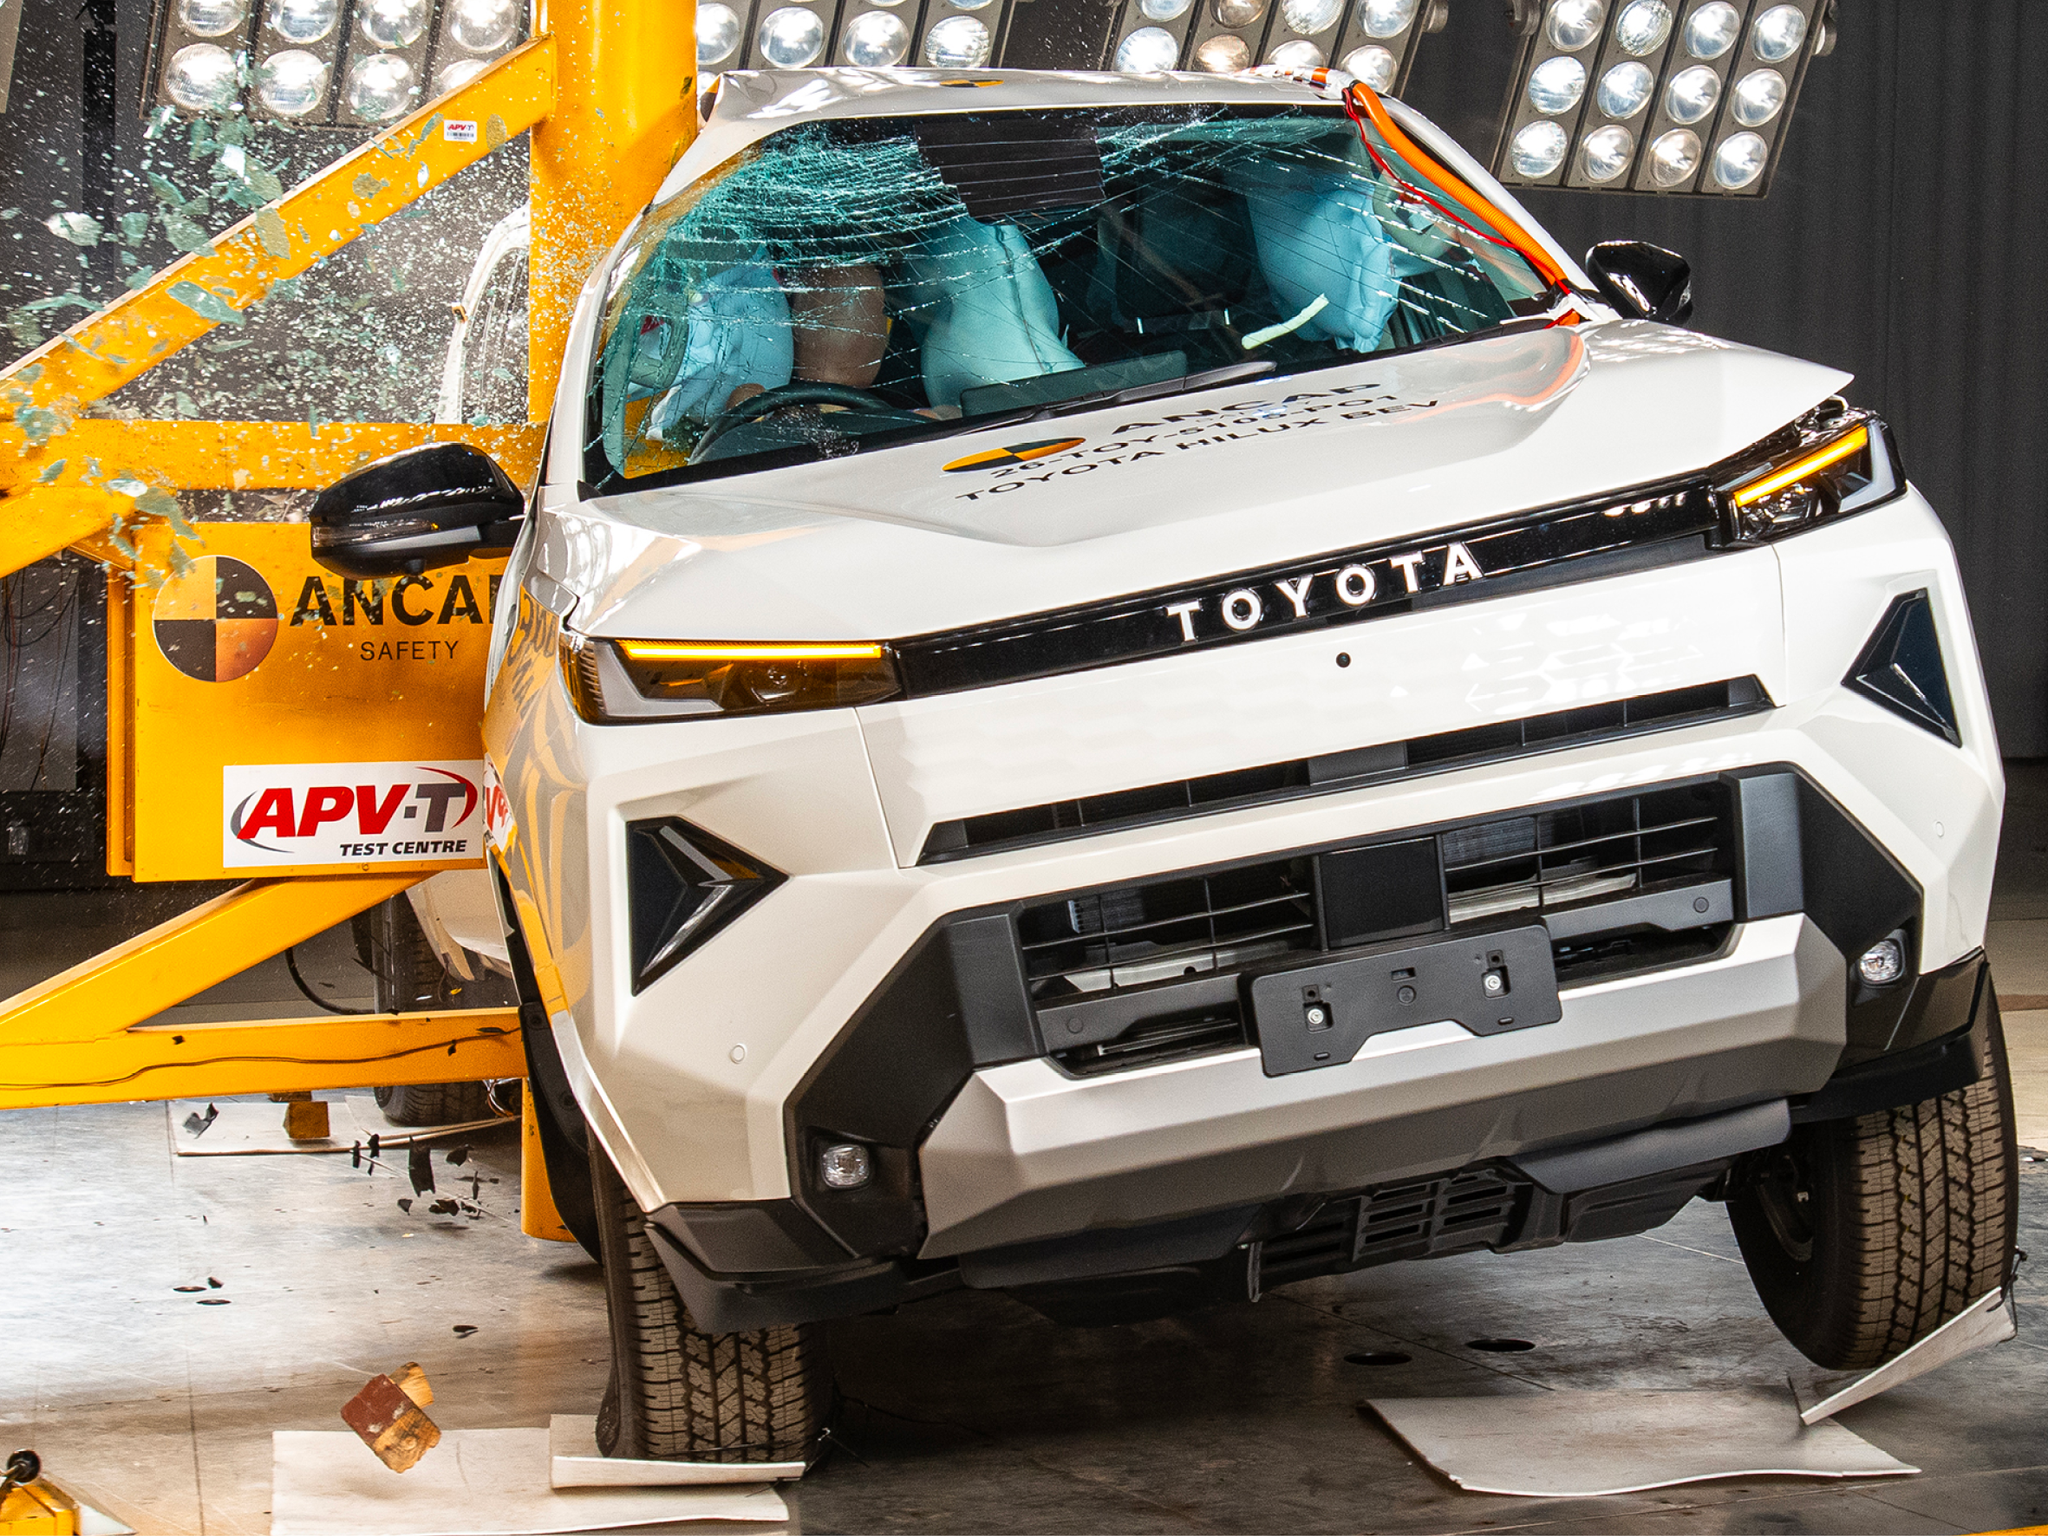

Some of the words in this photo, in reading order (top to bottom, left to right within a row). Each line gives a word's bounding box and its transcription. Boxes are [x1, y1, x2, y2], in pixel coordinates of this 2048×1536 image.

[1112, 386, 1381, 435] ANCAP
[954, 451, 1166, 501] TOYOTA
[1176, 418, 1330, 450] HILUX
[1340, 400, 1439, 420] BEV
[1166, 540, 1485, 644] TOYOTA
[360, 640, 459, 661] SAFETY
[339, 842, 389, 857] TEST
[391, 839, 467, 855] CENTRE
